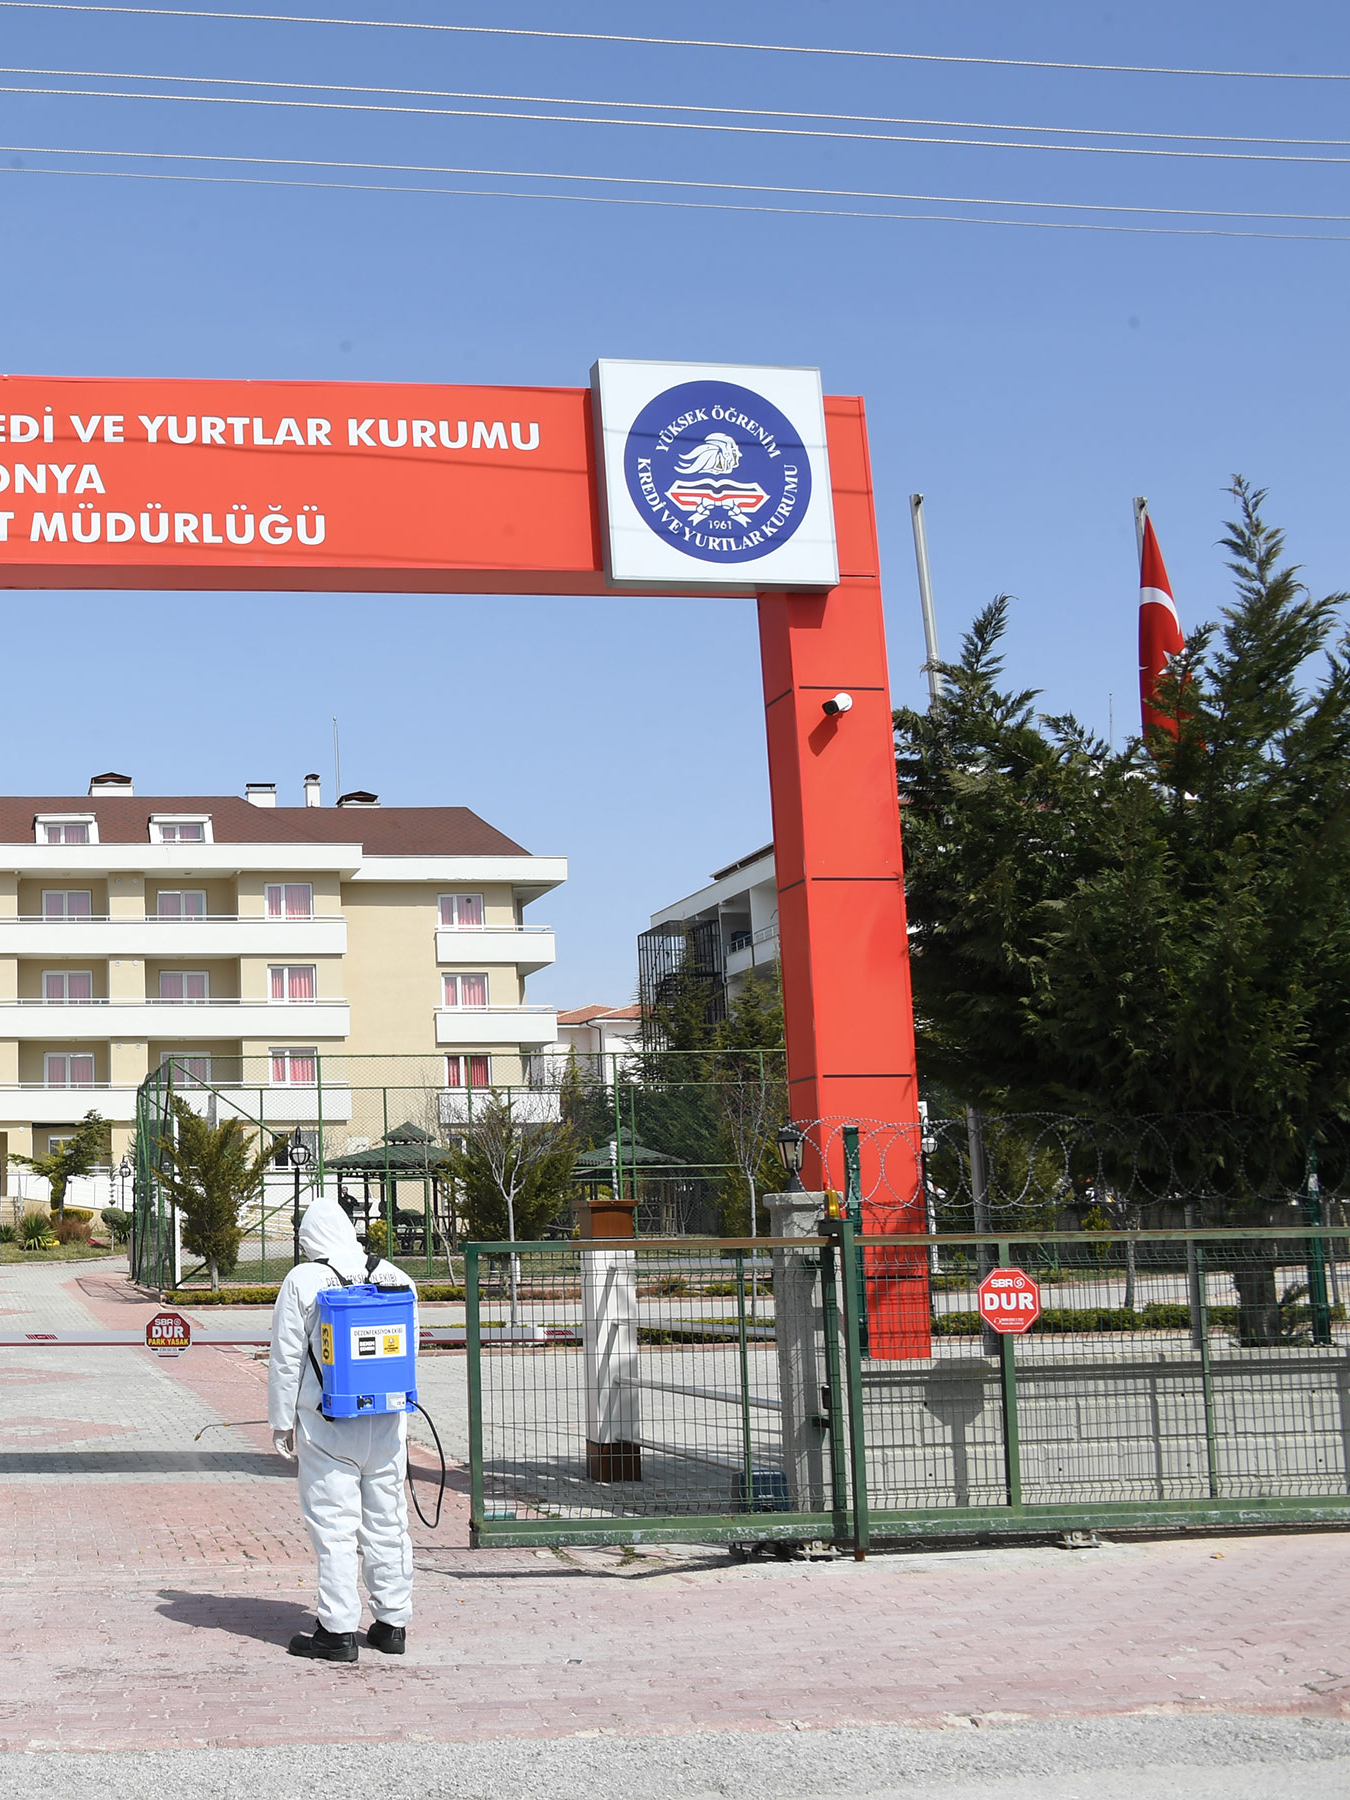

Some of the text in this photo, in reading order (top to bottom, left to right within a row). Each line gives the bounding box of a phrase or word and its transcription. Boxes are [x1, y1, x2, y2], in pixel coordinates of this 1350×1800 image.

[69, 414, 125, 443] VE
[138, 415, 333, 446] YURTLAR
[348, 418, 540, 451] KURUMU
[655, 405, 781, 459] YÜKSEK ÖĞRENİM
[637, 457, 799, 552] KREDİ VE YURTLAR KURUMU
[29, 503, 326, 546] MÜDÜRLÜĞÜ
[708, 519, 732, 530] 1961
[990, 1278, 1014, 1288] SBR
[983, 1292, 1035, 1311] DUR
[152, 1325, 184, 1338] DUR
